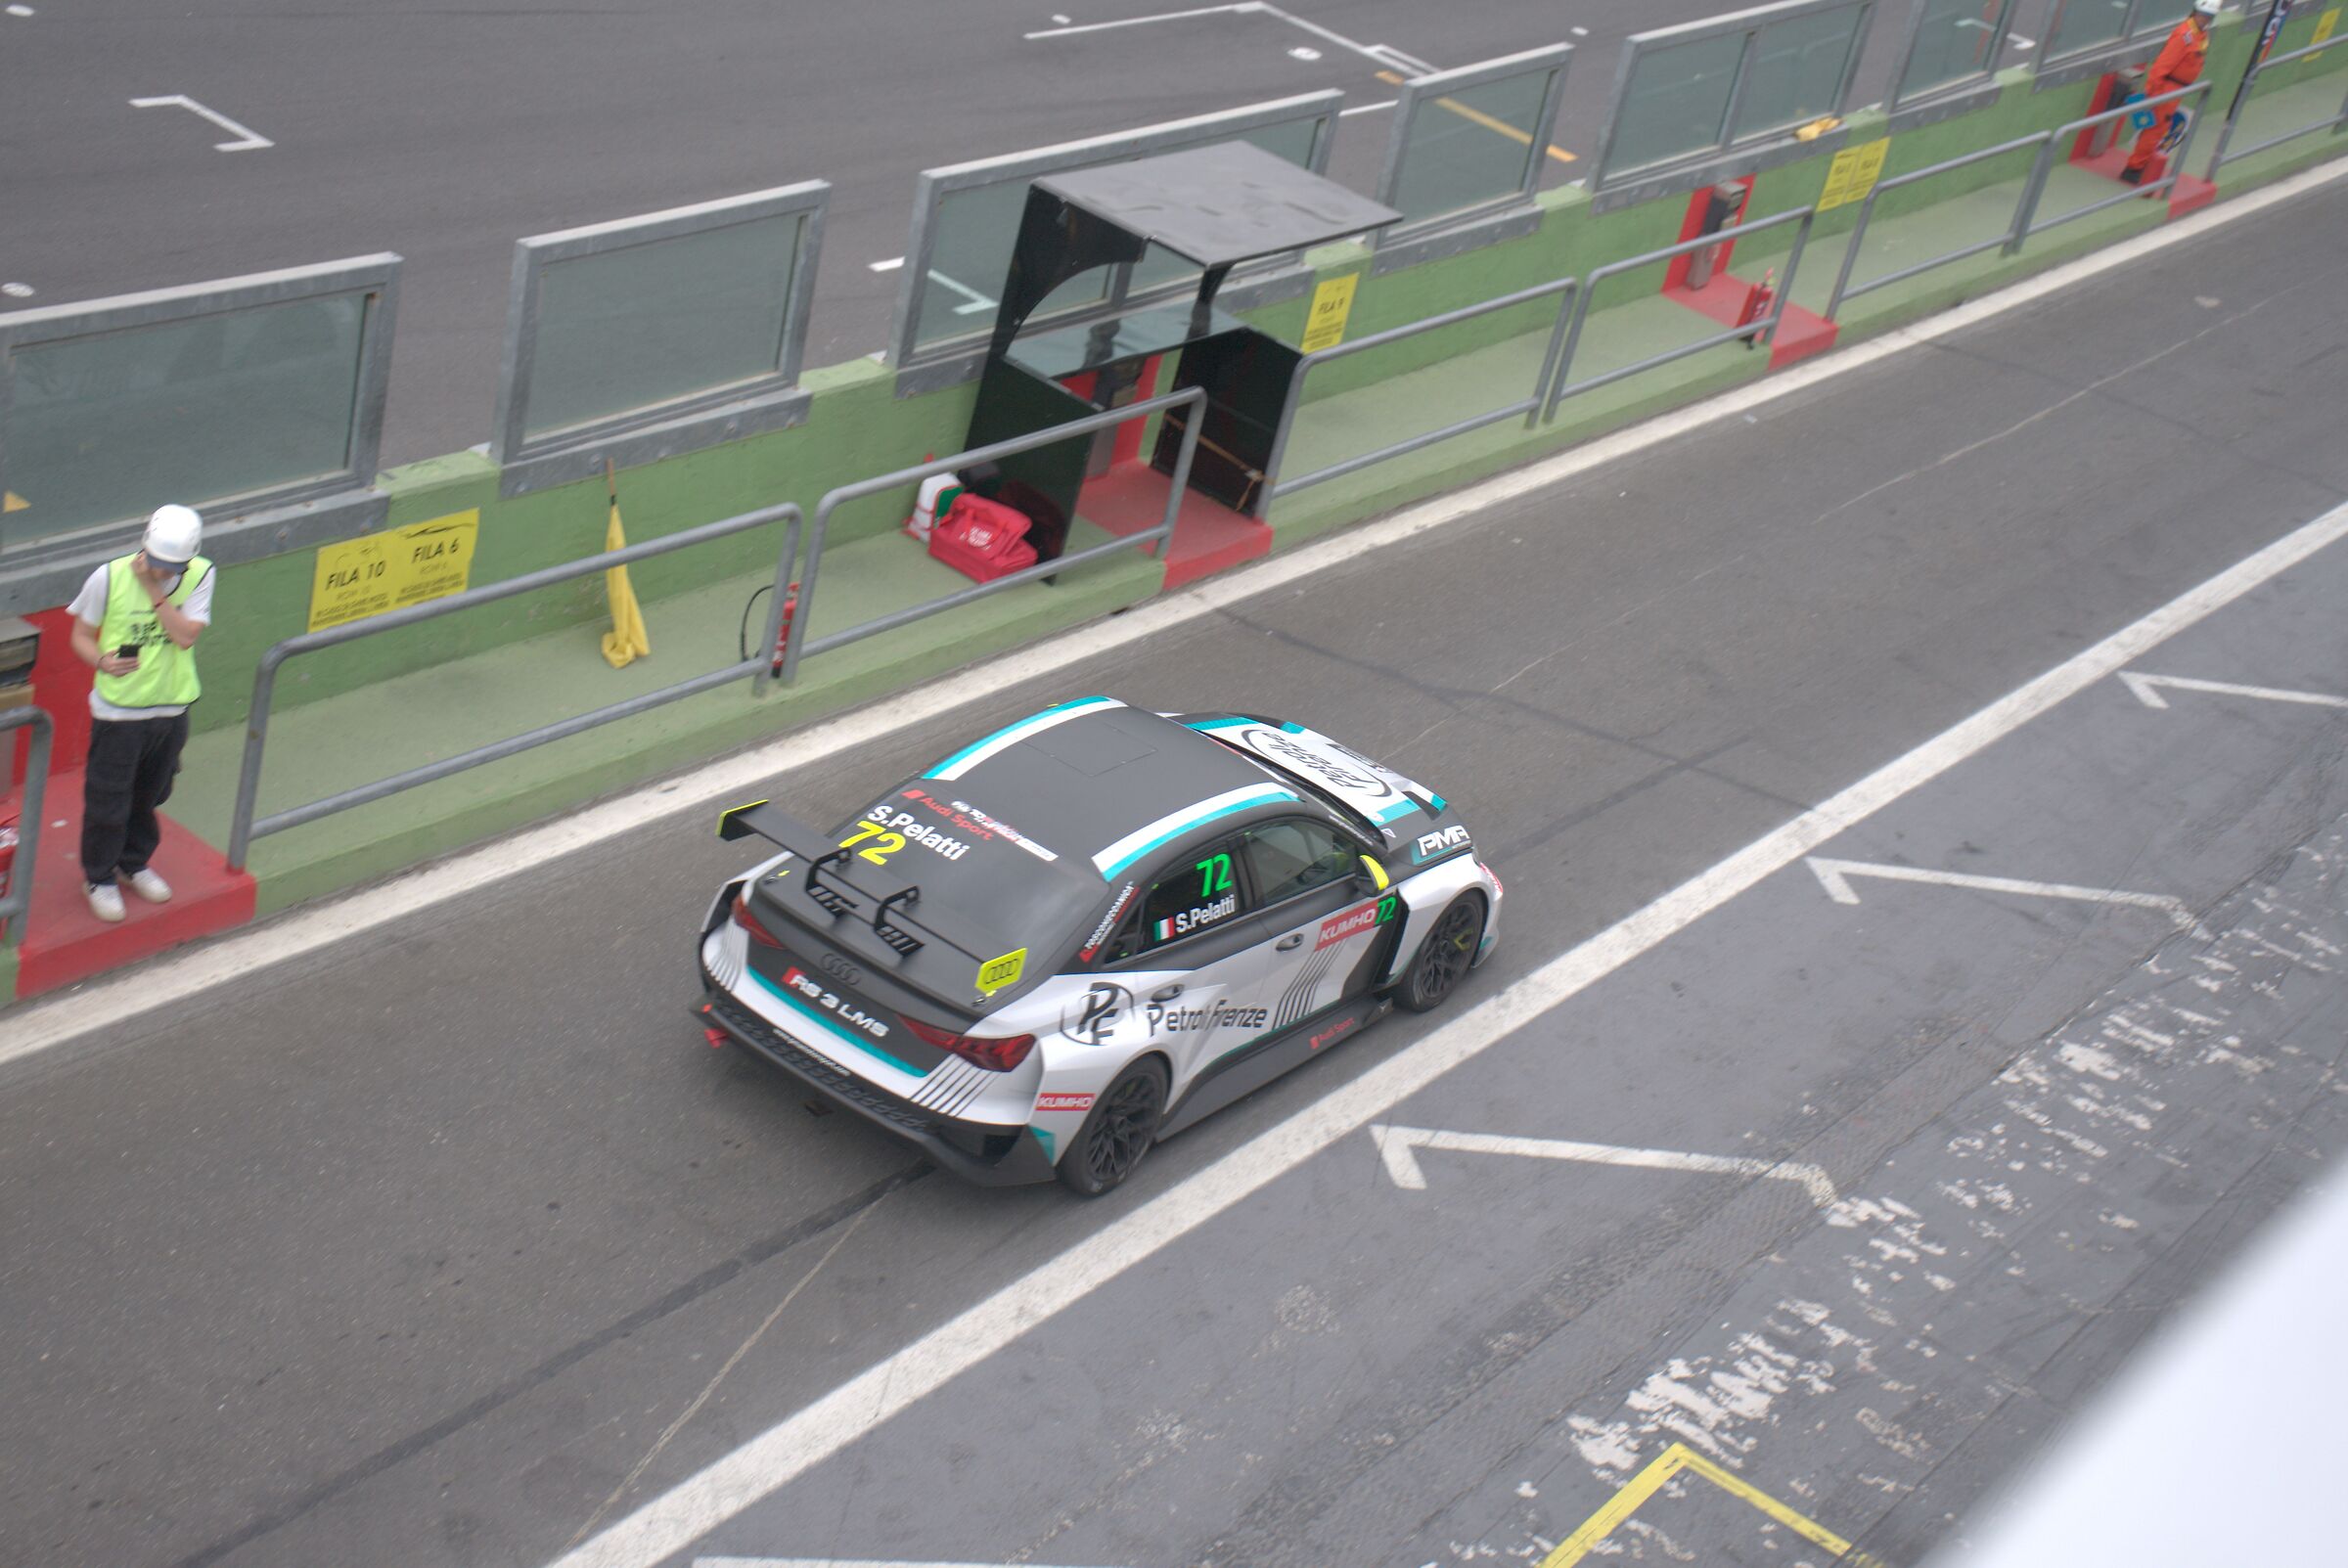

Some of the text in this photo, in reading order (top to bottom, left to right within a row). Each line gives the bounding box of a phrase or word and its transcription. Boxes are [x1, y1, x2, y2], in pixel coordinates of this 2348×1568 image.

[412, 537, 460, 563] FILA 6
[325, 560, 386, 591] FILA 10
[920, 795, 953, 818] Audi
[950, 813, 993, 841] Sport
[838, 820, 907, 866] 72
[1196, 853, 1234, 898] 72
[1320, 907, 1377, 943] KUMHO
[1375, 896, 1397, 925] 72
[1038, 1096, 1093, 1108] KUMHO
